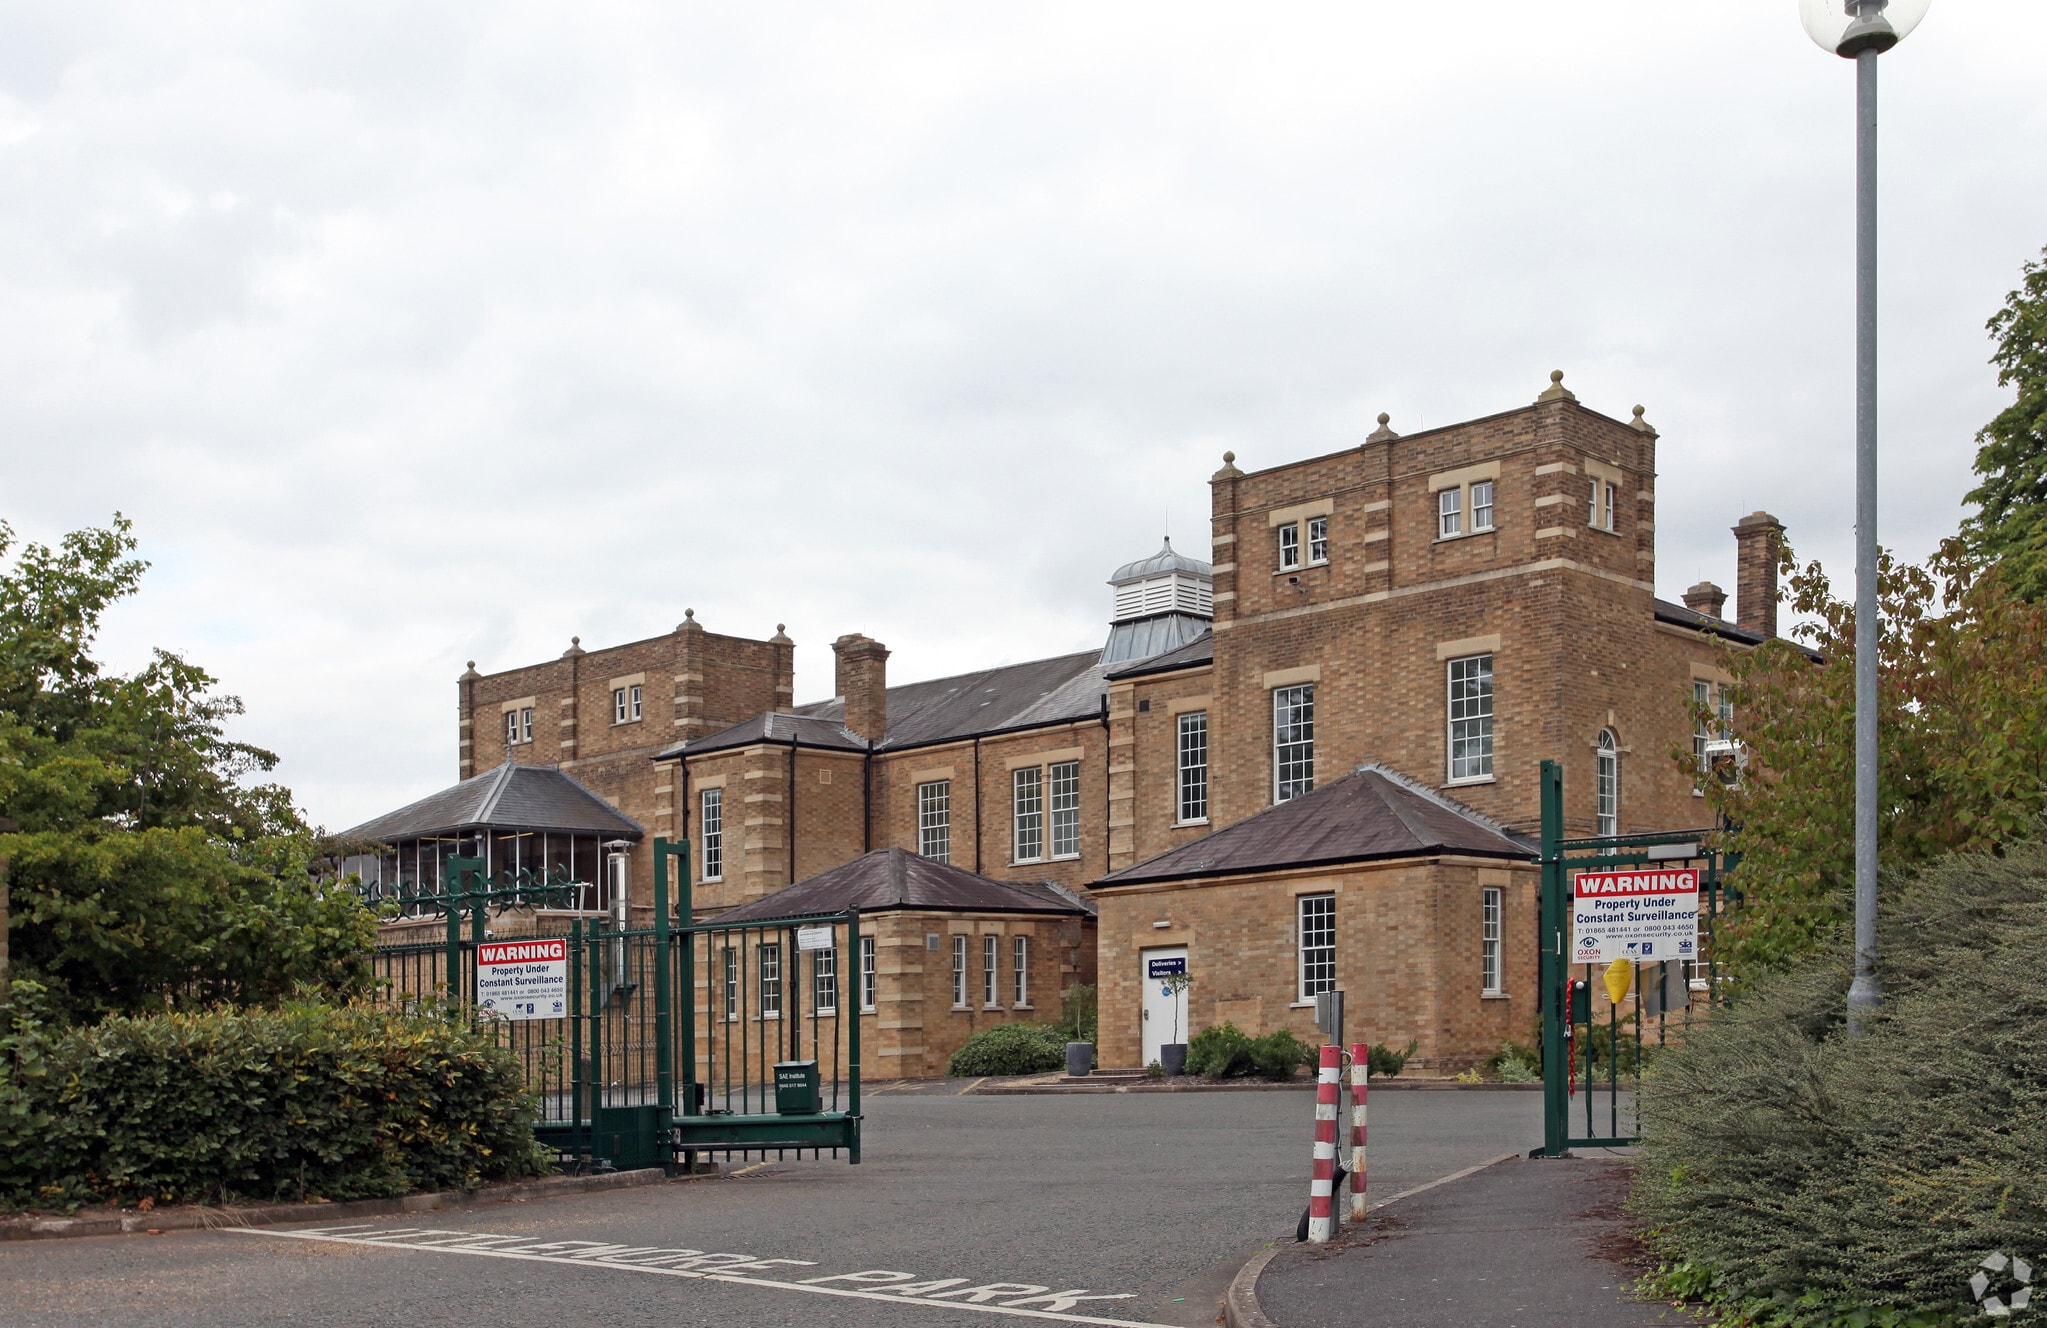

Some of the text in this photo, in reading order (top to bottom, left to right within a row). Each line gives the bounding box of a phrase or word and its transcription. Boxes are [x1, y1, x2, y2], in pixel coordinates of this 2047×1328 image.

[1580, 873, 1694, 894] WARNING
[1595, 897, 1676, 911] Property Under
[1576, 910, 1694, 923] Constant Surveillance
[1605, 930, 1693, 939] www.oxonsecurity.co.uk
[481, 943, 562, 962] WARNING
[492, 964, 549, 976] Property Under
[480, 975, 563, 988] Constant Surveillance
[285, 1224, 1138, 1312] LITTLEMORE PARK
